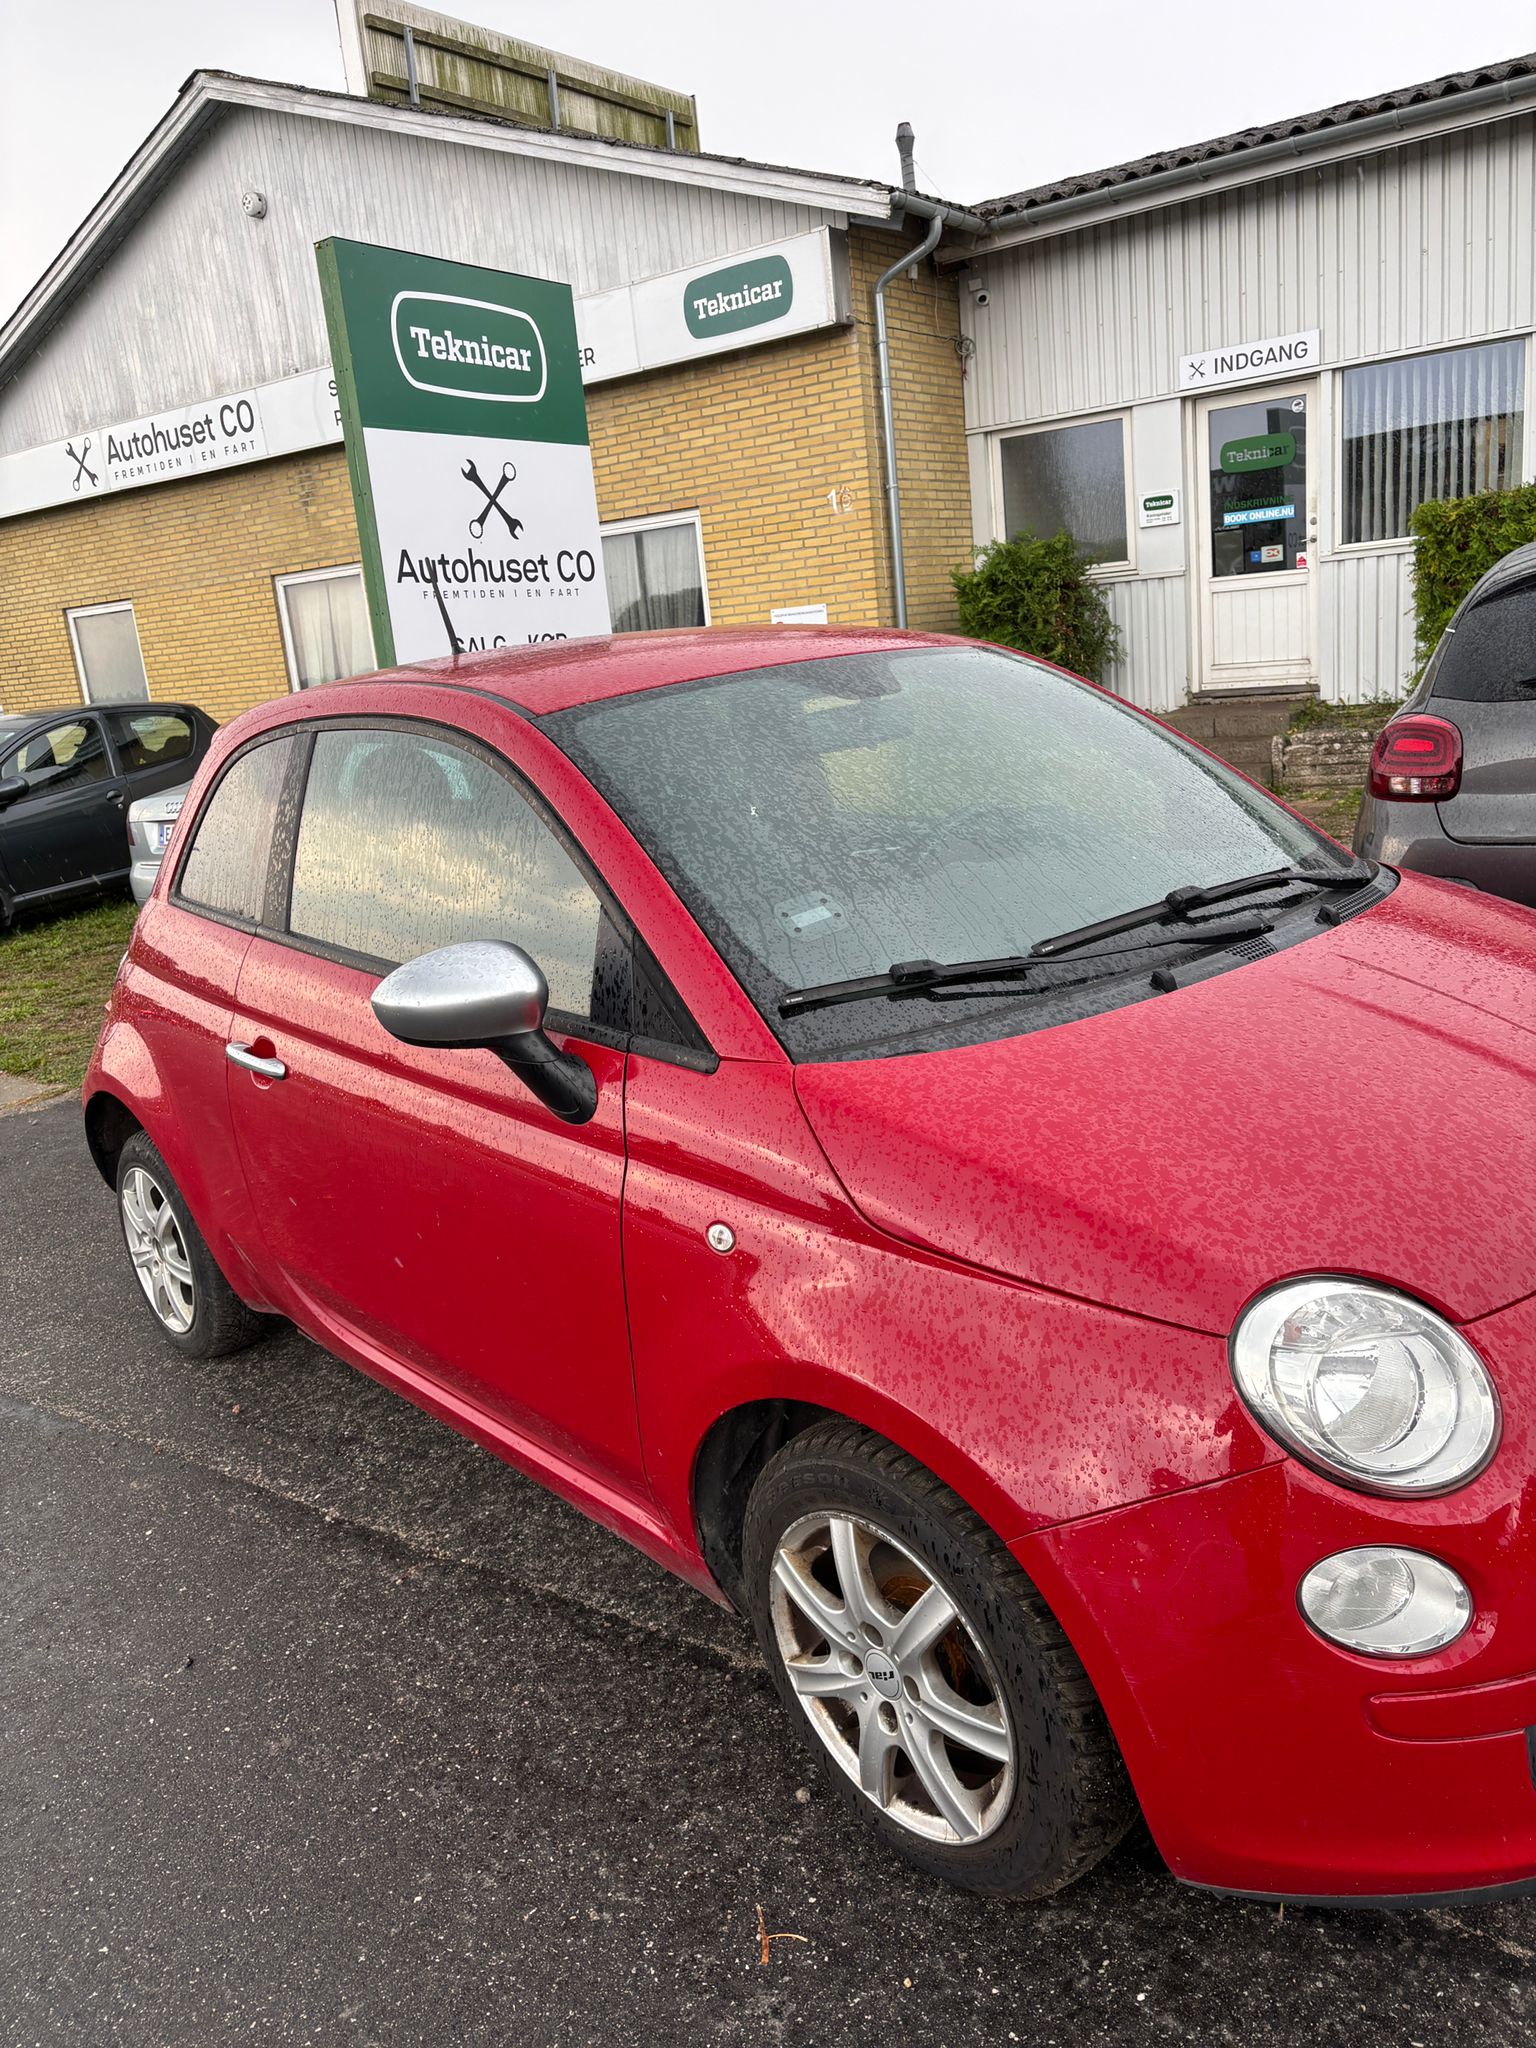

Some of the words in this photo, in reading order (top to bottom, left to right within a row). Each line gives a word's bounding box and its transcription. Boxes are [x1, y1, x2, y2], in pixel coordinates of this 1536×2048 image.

[693, 279, 783, 320] Teknicar
[409, 325, 532, 373] Teknicar
[1214, 340, 1309, 375] INDGANG
[107, 413, 216, 465] Autohuset
[219, 399, 255, 437] CO
[114, 457, 182, 480] FREMTIDEN
[190, 454, 194, 464] I
[201, 449, 216, 461] EN
[224, 440, 256, 456] FART
[1226, 444, 1290, 463] Teknicar
[1223, 512, 1248, 524] BOOK
[397, 547, 551, 584] Autohuset
[557, 550, 595, 583] CO
[423, 589, 505, 600] FREMTIDEN
[514, 589, 518, 598] I
[527, 589, 542, 598] EN
[550, 588, 581, 597] FART
